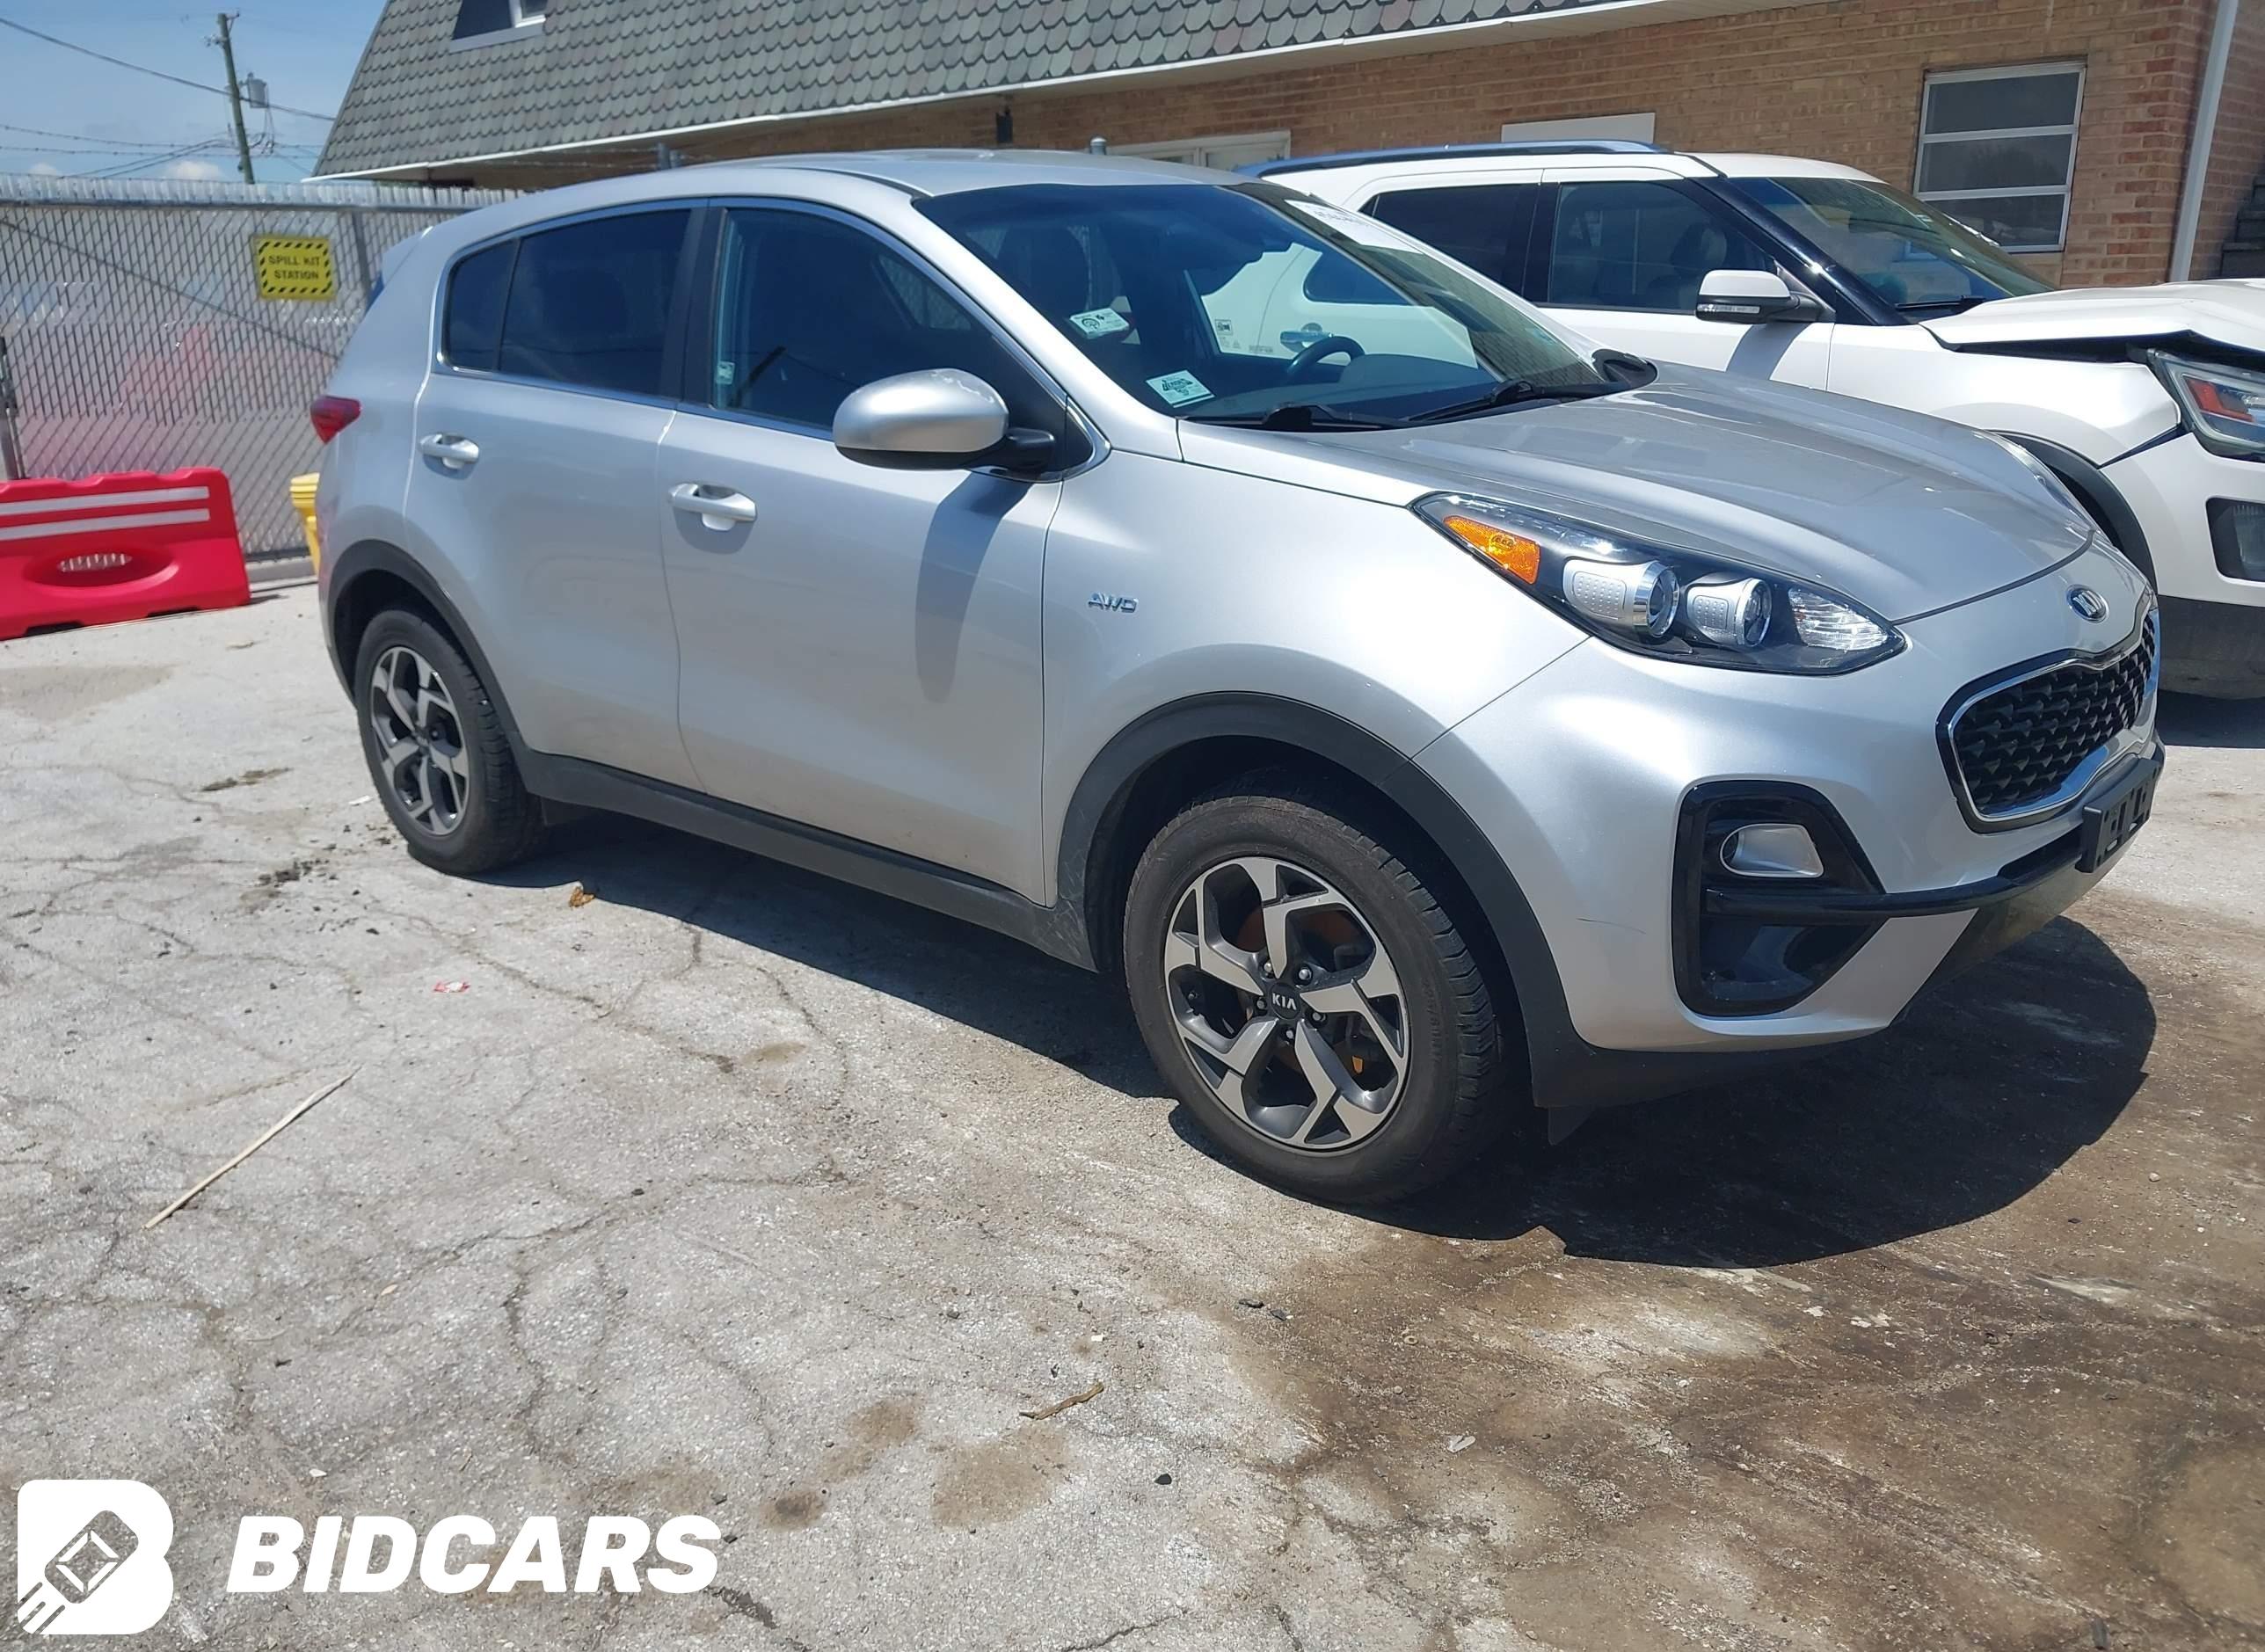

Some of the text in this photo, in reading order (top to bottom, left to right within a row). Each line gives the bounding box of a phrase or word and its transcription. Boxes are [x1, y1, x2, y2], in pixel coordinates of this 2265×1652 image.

[268, 255, 320, 266] SPILL KIT
[274, 270, 318, 280] STATION
[1088, 592, 1139, 614] AWD
[1271, 992, 1297, 1011] KIA
